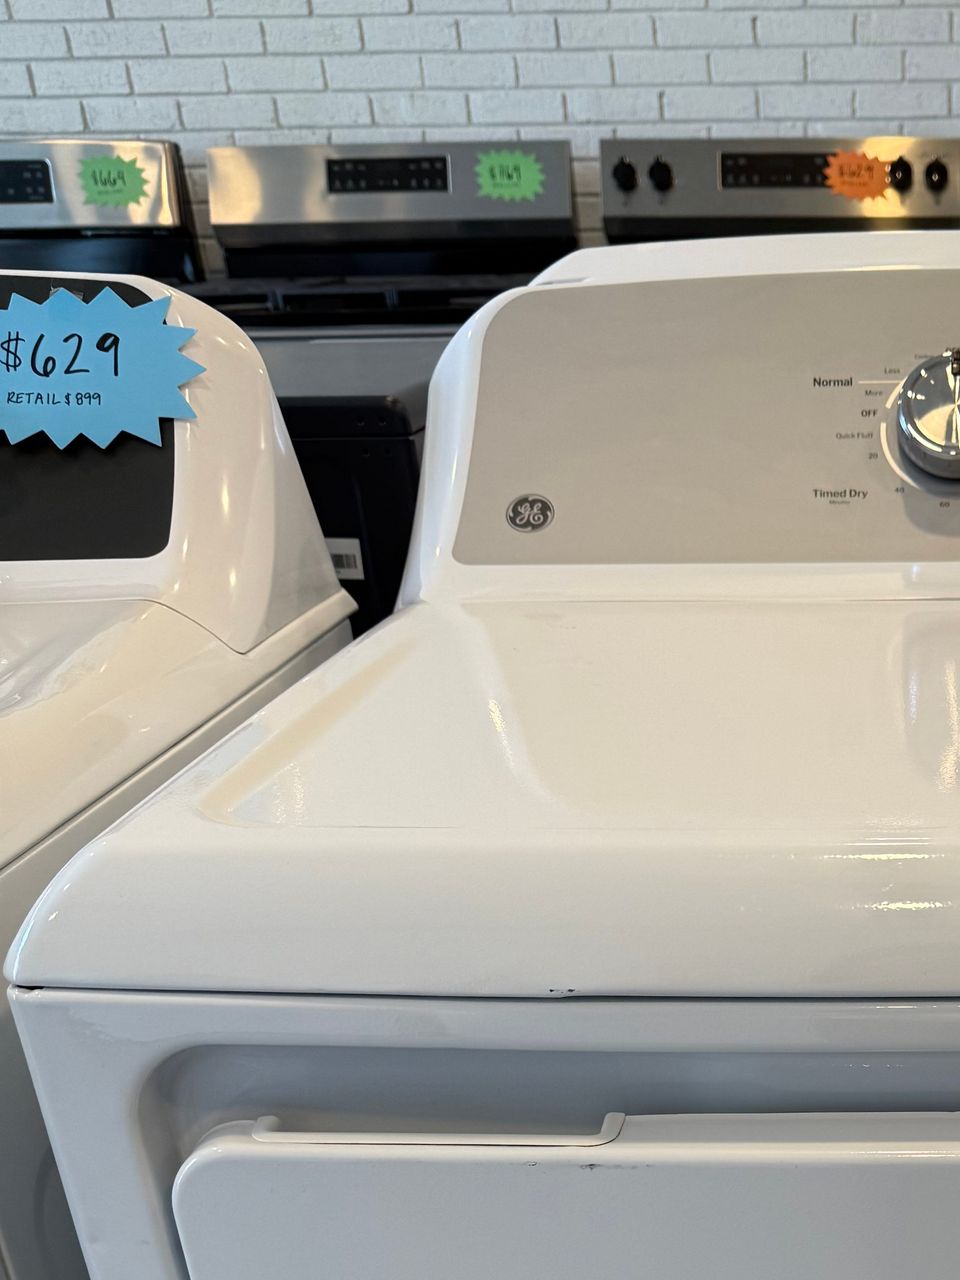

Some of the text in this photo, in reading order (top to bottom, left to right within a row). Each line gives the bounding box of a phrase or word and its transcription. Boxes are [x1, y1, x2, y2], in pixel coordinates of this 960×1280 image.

[0, 331, 120, 377] $629
[813, 377, 853, 388] Normal
[7, 391, 102, 406] RETAIL $899
[861, 409, 878, 418] OFF
[813, 488, 868, 499] Timed Dry
